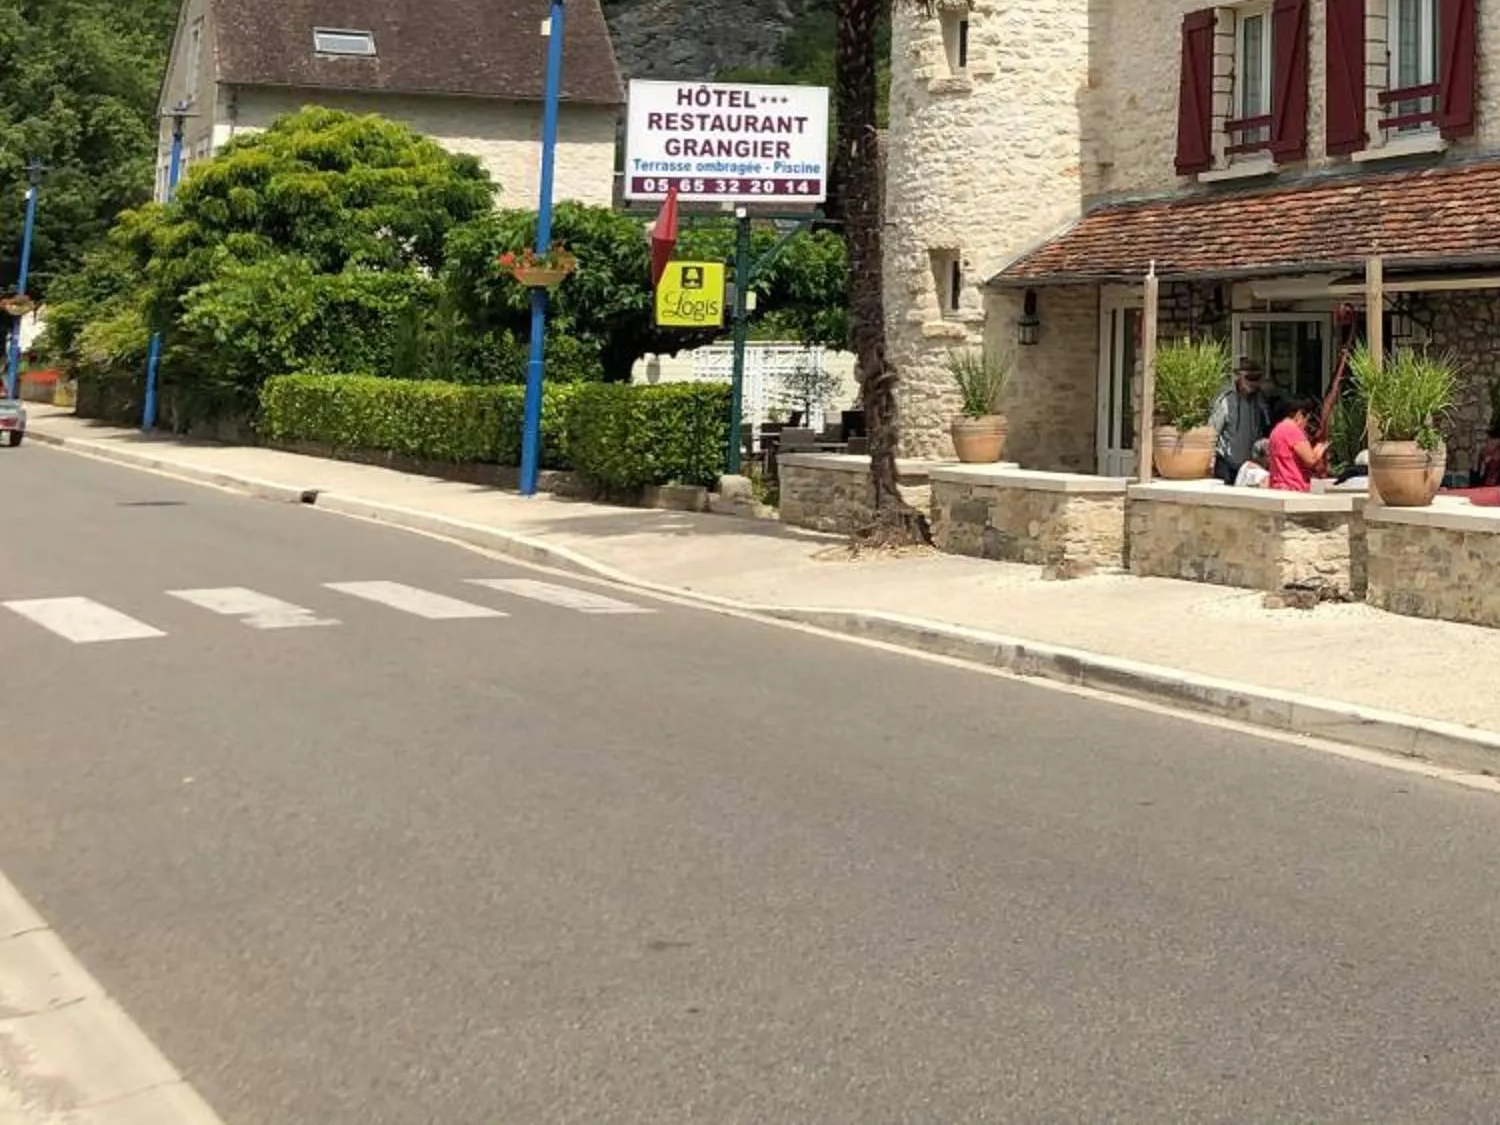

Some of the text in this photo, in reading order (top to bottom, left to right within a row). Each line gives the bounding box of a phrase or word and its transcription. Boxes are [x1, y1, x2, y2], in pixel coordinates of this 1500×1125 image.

[677, 85, 756, 108] HÔTEL
[648, 112, 808, 133] RESTAURANT
[665, 138, 790, 158] GRANGIER
[633, 158, 692, 172] Terrasse
[696, 160, 761, 175] ombragée
[773, 161, 820, 174] Piscine
[643, 178, 809, 193] 05 65 32 20 14
[662, 290, 719, 321] Logis
